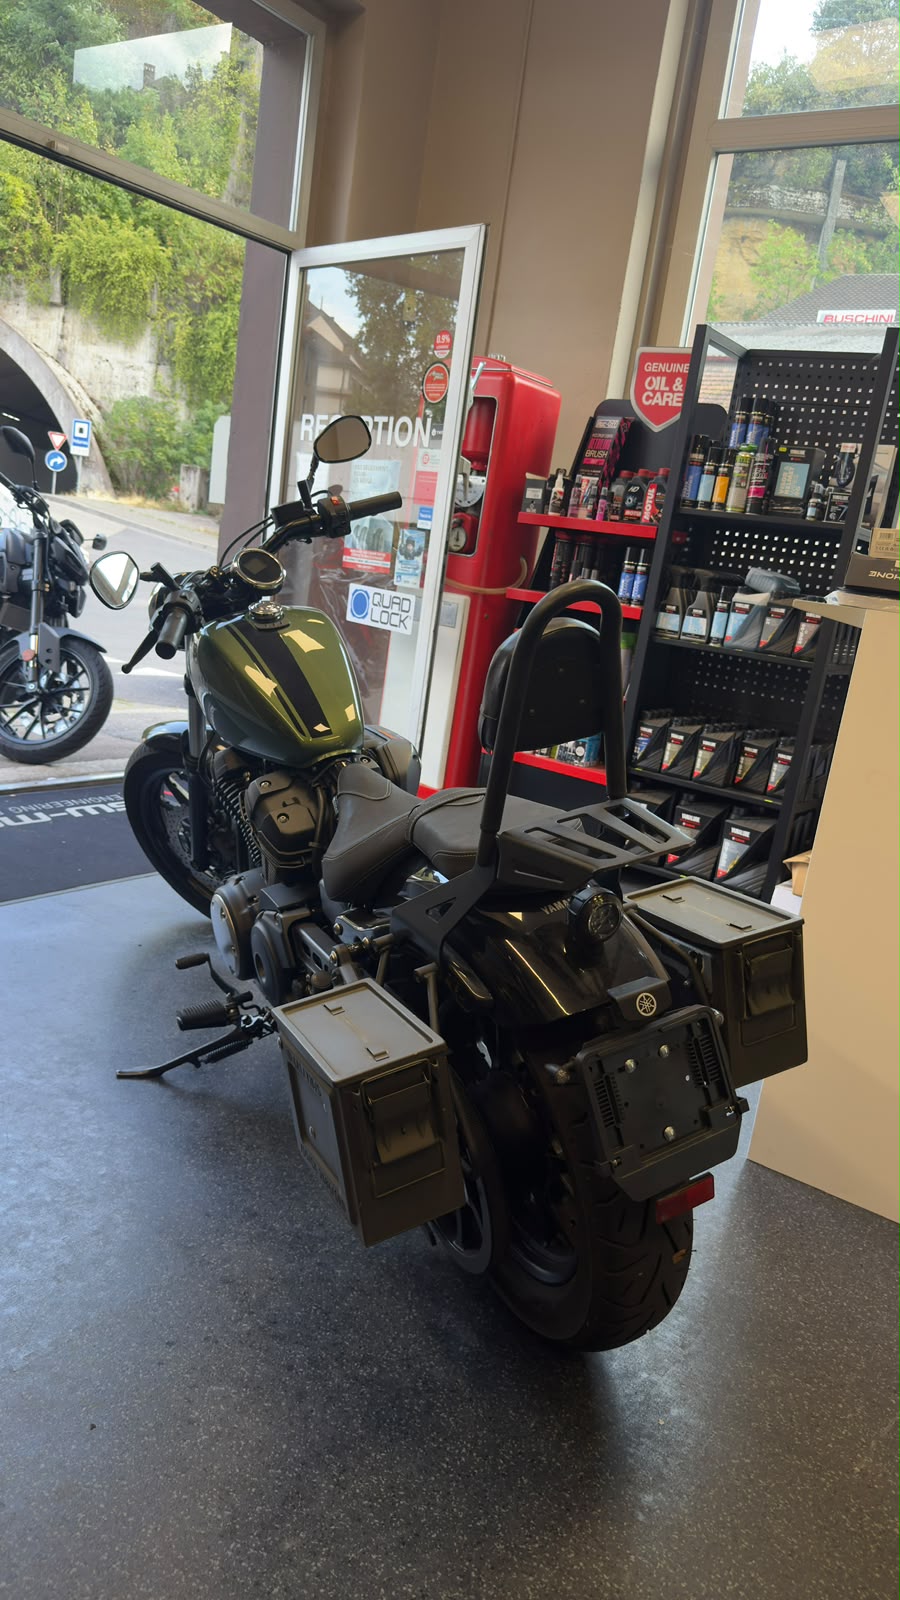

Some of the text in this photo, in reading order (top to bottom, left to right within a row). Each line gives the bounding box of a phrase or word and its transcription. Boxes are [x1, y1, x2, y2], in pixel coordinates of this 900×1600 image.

[823, 314, 894, 323] BUSCHINI
[644, 362, 690, 374] GENUINE
[644, 376, 683, 391] OIL &
[641, 391, 684, 407] CARE
[300, 414, 432, 448] RETION
[585, 449, 608, 459] BRUSH
[628, 485, 640, 493] HD
[643, 488, 656, 521] MOTUL
[372, 592, 412, 613] QUAD
[370, 608, 409, 630] LOCK
[8, 793, 124, 814] ENGINEERING
[0, 801, 126, 828] SW-M
[540, 898, 570, 915] YAMA
